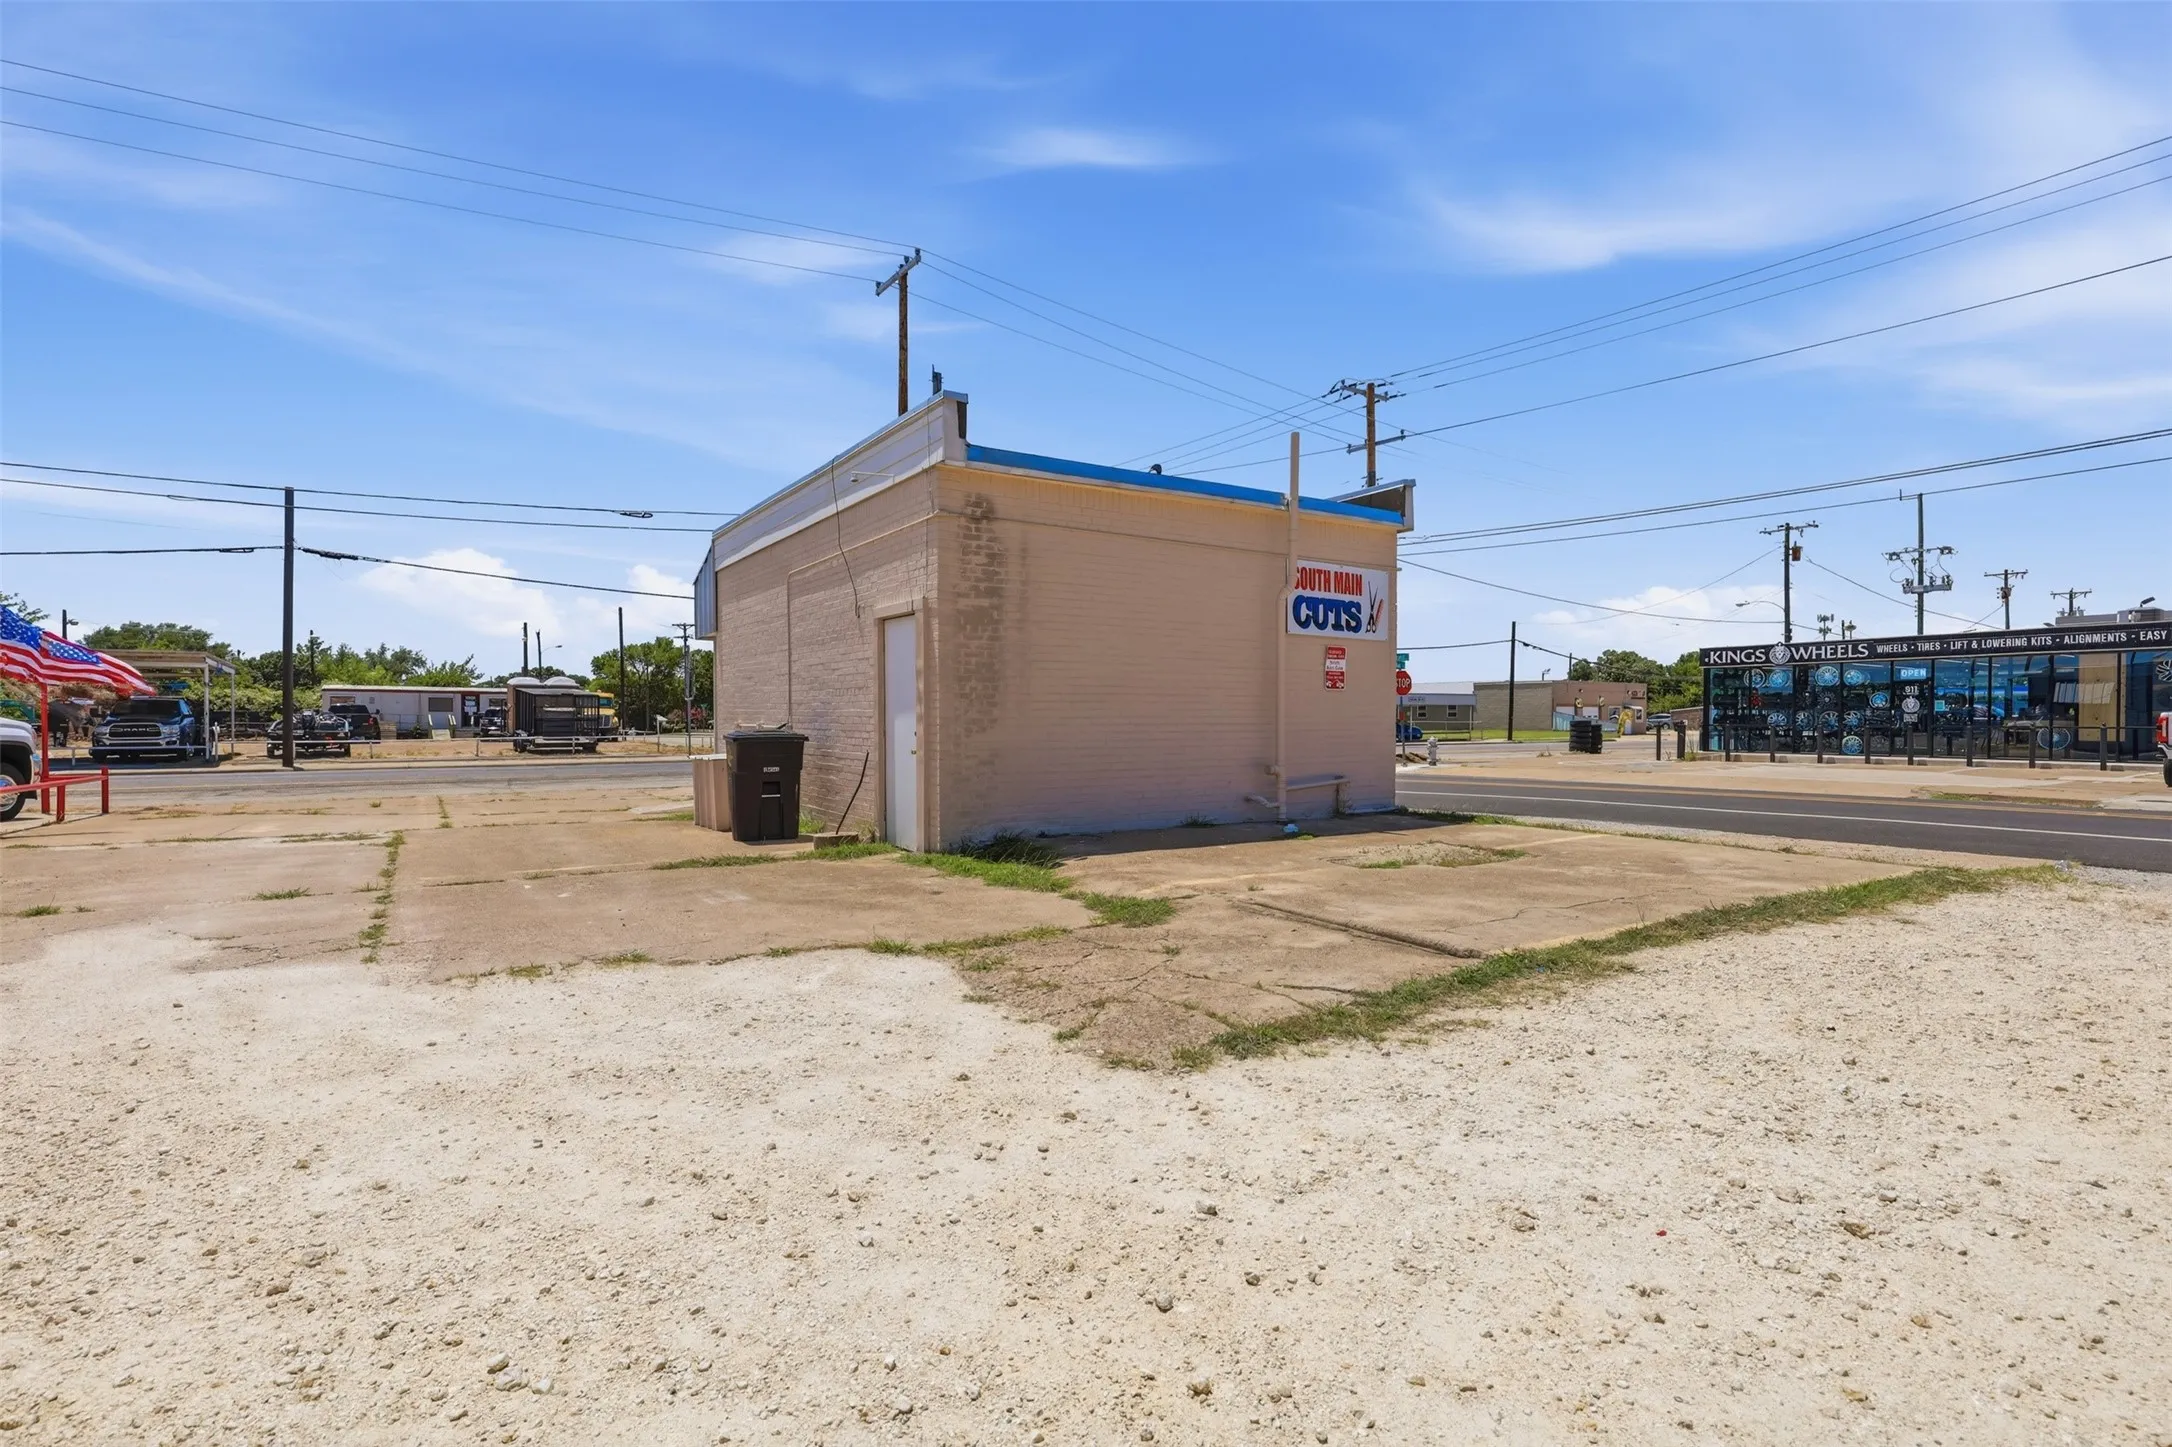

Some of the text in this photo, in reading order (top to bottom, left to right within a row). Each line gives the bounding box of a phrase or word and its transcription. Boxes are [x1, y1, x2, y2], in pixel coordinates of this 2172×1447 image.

[1333, 571, 1363, 597] MAIN
[1292, 594, 1363, 634] CUTS
[1876, 630, 2168, 654] WHEELS TIRES LIFT & LOWERING KITS ALIGNMENTS EASY
[1710, 643, 1870, 664] KINGS WHEELS
[1396, 677, 1411, 689] TOP
[1900, 668, 1927, 678] OPEN
